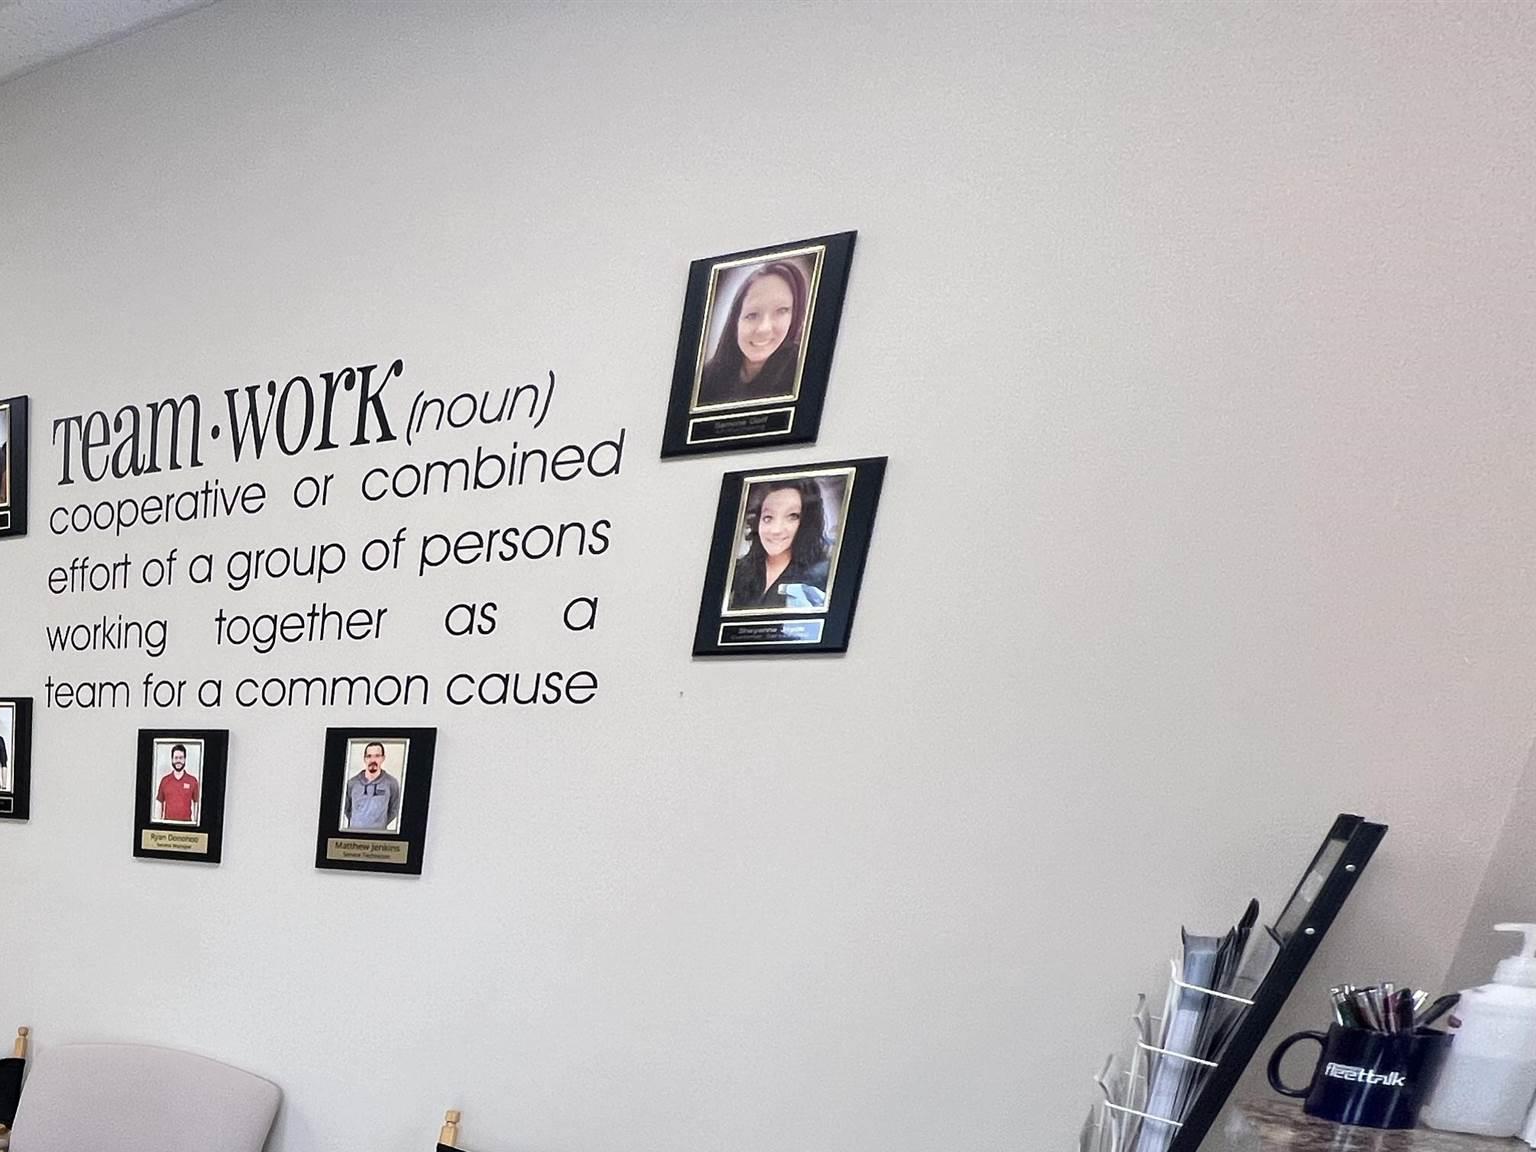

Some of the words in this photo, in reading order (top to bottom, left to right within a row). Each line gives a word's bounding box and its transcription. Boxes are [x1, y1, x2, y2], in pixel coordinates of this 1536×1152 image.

[406, 370, 555, 450] (noun)
[49, 478, 266, 537] cooperative
[293, 473, 335, 509] or
[361, 428, 626, 502] combined
[48, 553, 132, 595] effort
[142, 548, 178, 587] of
[188, 554, 213, 584] a
[226, 543, 346, 592] group
[361, 526, 407, 572] of
[418, 519, 611, 577] persons
[46, 614, 168, 658] working
[214, 602, 388, 654] together
[444, 602, 498, 636] as
[563, 596, 599, 631] a
[44, 675, 130, 709] team
[142, 672, 187, 708] for
[198, 679, 222, 708] a
[235, 674, 429, 708] common
[446, 670, 598, 706] cause
[335, 841, 369, 851] Matthew
